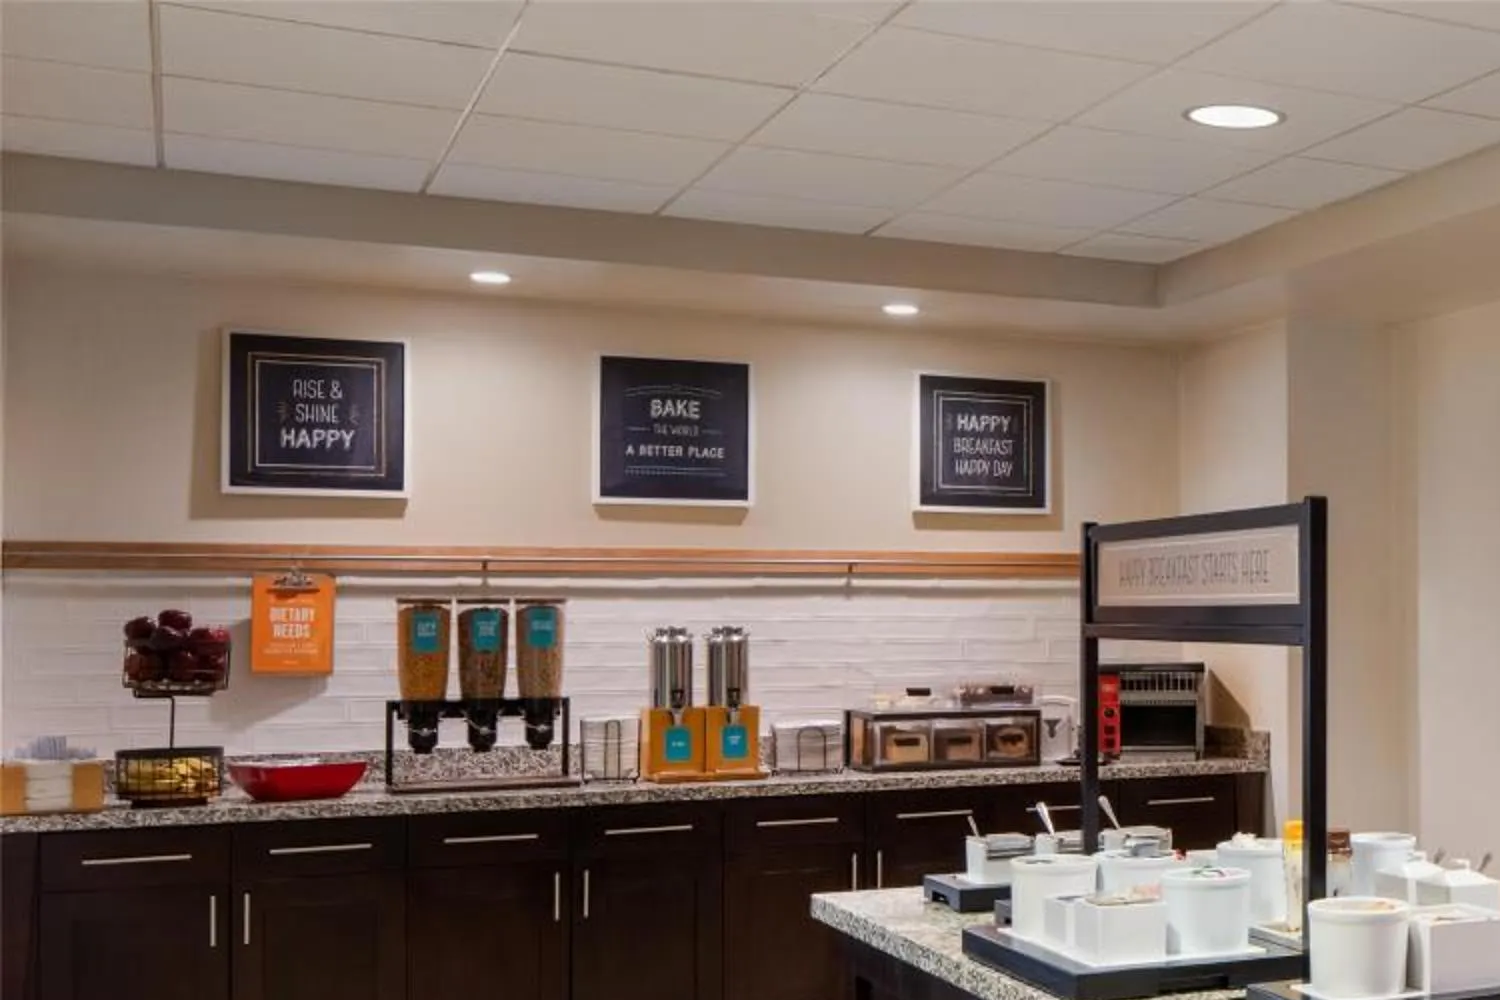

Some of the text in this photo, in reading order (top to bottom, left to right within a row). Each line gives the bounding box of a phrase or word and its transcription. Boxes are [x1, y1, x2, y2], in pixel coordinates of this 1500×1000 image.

[293, 379, 343, 399] RISE &
[295, 403, 340, 424] SHINE
[650, 399, 701, 419] BAKE
[957, 414, 1011, 432] HAPPY
[280, 428, 355, 449] HAPPY
[953, 438, 1012, 456] BREAKFAST
[625, 445, 725, 459] A BETTER PLACE
[955, 459, 1012, 477] HAPPY DAY
[270, 607, 315, 622] DIETARY
[273, 623, 311, 639] NEEDS
